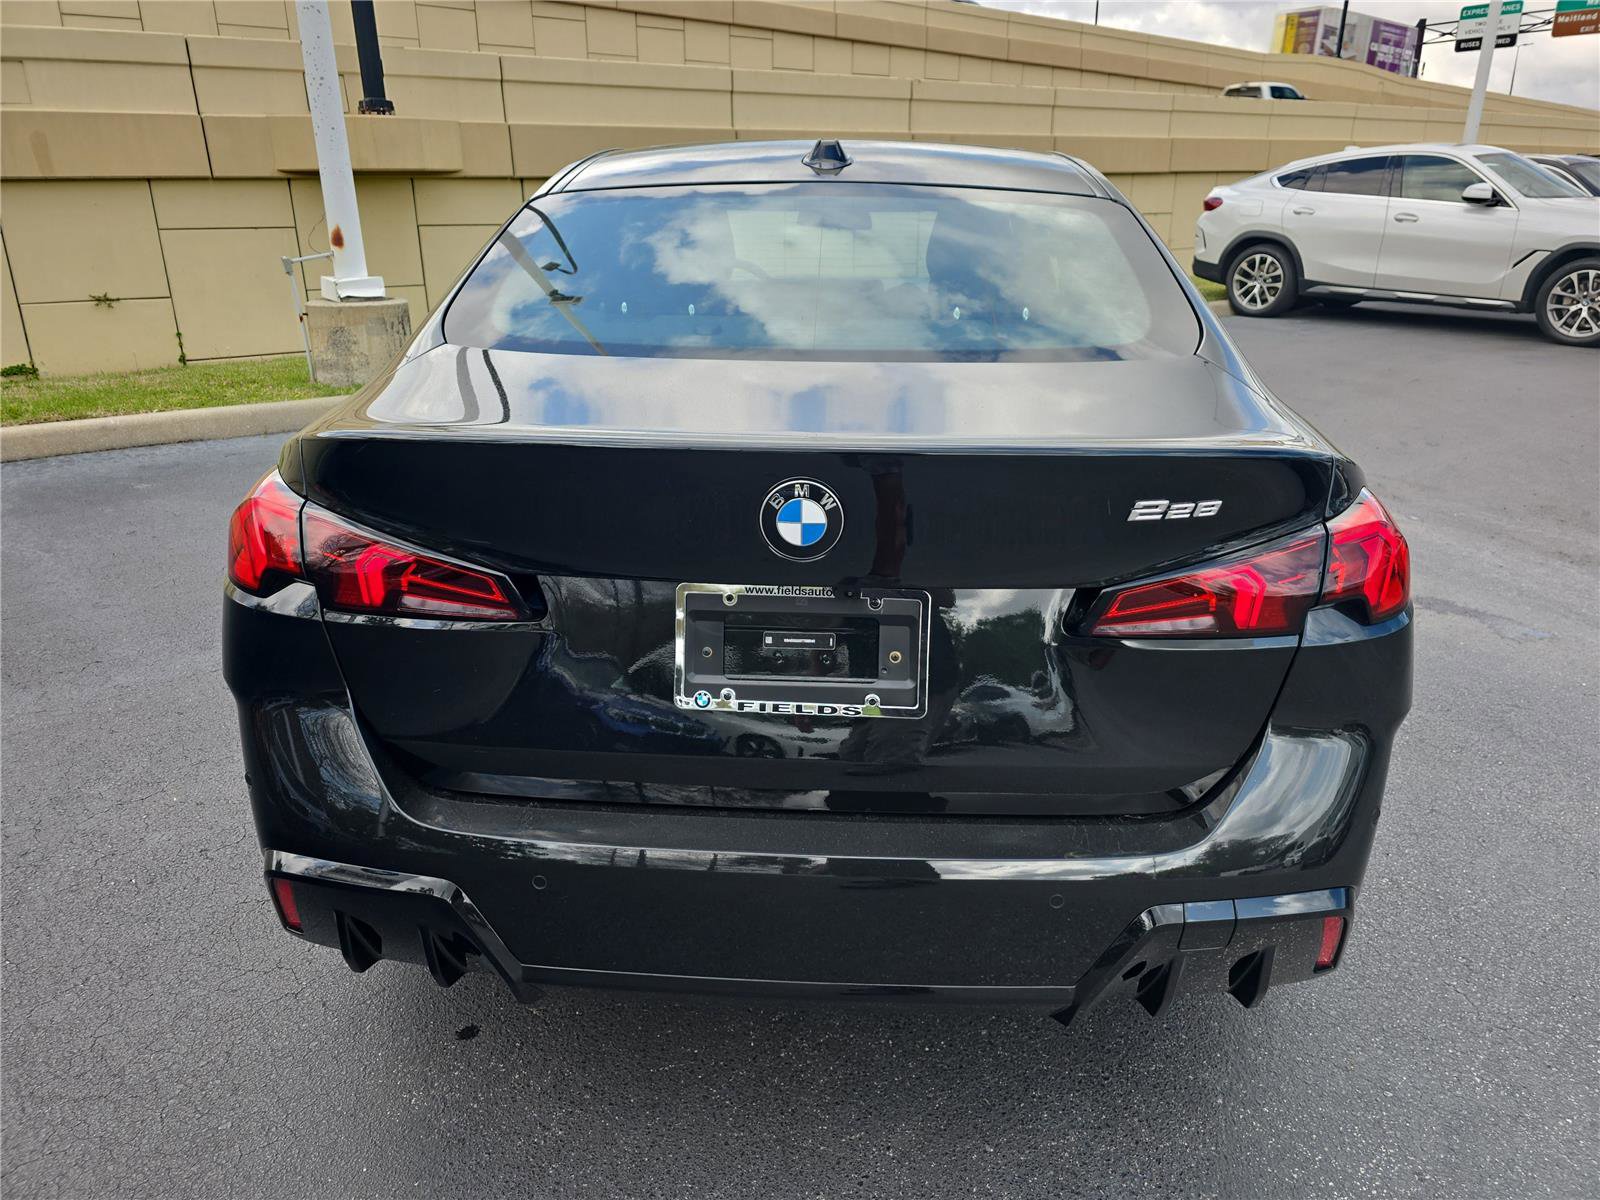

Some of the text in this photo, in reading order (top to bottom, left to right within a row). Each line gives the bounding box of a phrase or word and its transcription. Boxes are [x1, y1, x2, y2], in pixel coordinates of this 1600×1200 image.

[1501, 3, 1521, 11] ANES
[1460, 40, 1480, 49] BUSES
[768, 483, 838, 512] BMW
[1127, 498, 1223, 522] 228
[744, 585, 834, 598] www.fieldsauto
[737, 701, 862, 716] FIELDS
